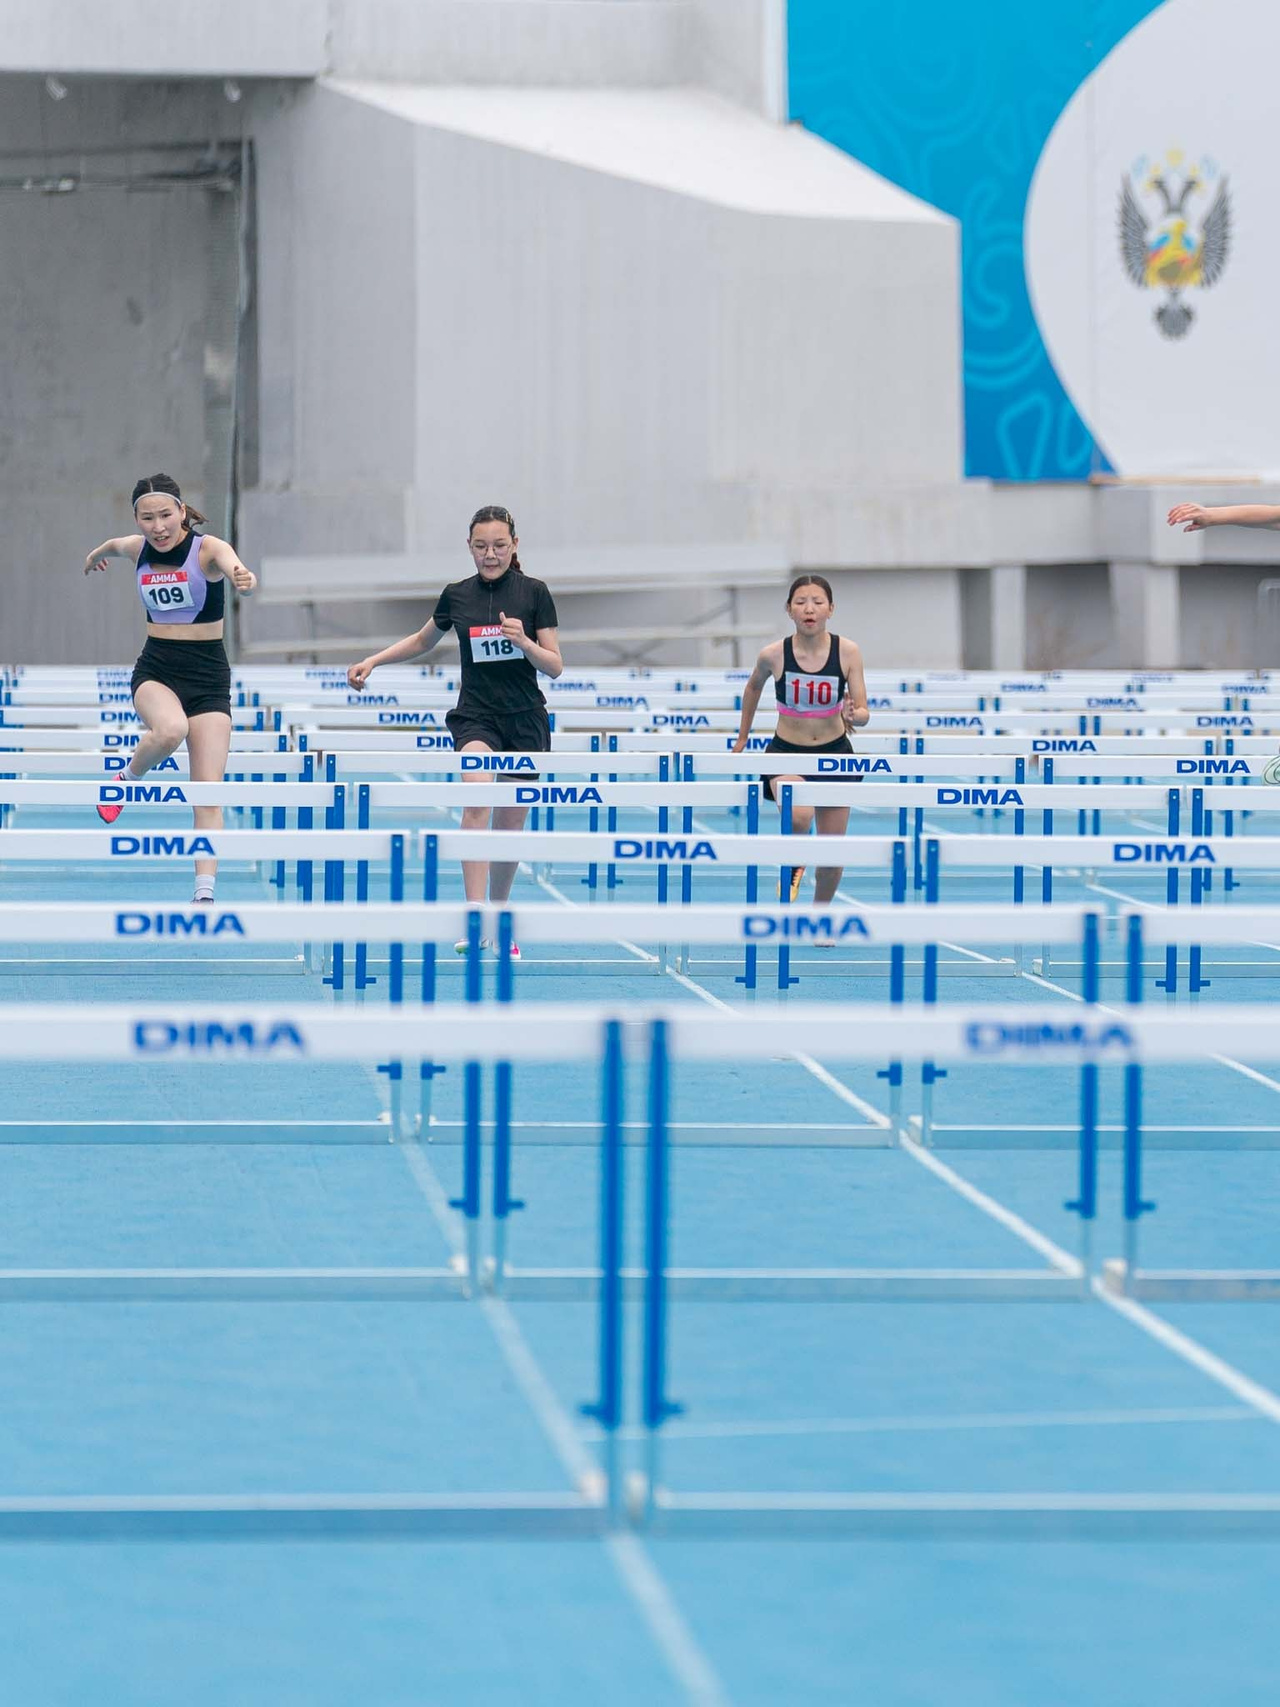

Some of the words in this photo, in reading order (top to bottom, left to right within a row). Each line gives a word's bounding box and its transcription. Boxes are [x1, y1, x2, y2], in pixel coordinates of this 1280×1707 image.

[149, 586, 185, 606] 109
[481, 627, 503, 637] АММ
[481, 639, 514, 656] 118
[99, 693, 133, 704] DIM
[791, 678, 832, 706] 110
[347, 694, 400, 706] DIMA
[597, 696, 648, 708] DIMA
[867, 697, 892, 709] MA
[1087, 697, 1138, 708] DIMA
[101, 711, 141, 723] DIM
[378, 712, 436, 725] DIMA
[652, 714, 710, 727] DIMA
[926, 716, 984, 728] DIMA
[1197, 715, 1254, 728] DIMA
[104, 735, 140, 747] DIM
[416, 736, 455, 748] DIM
[727, 737, 773, 750] DIM
[1032, 739, 1097, 752] DIMA
[104, 757, 180, 771] DA
[461, 756, 536, 771] DIMA
[817, 757, 892, 773] DIMA
[1176, 759, 1251, 774] DIMA
[99, 786, 187, 804] DIMA
[516, 787, 603, 804] DIMA
[937, 788, 1024, 806] DIMA
[111, 835, 216, 857] DIMA
[614, 839, 718, 861] DIMA
[1112, 842, 1218, 864] DIMA
[115, 913, 245, 937] DIMA
[743, 915, 869, 938] DIMA
[134, 1020, 303, 1052] DIMA
[966, 1022, 1134, 1053] DIMA
